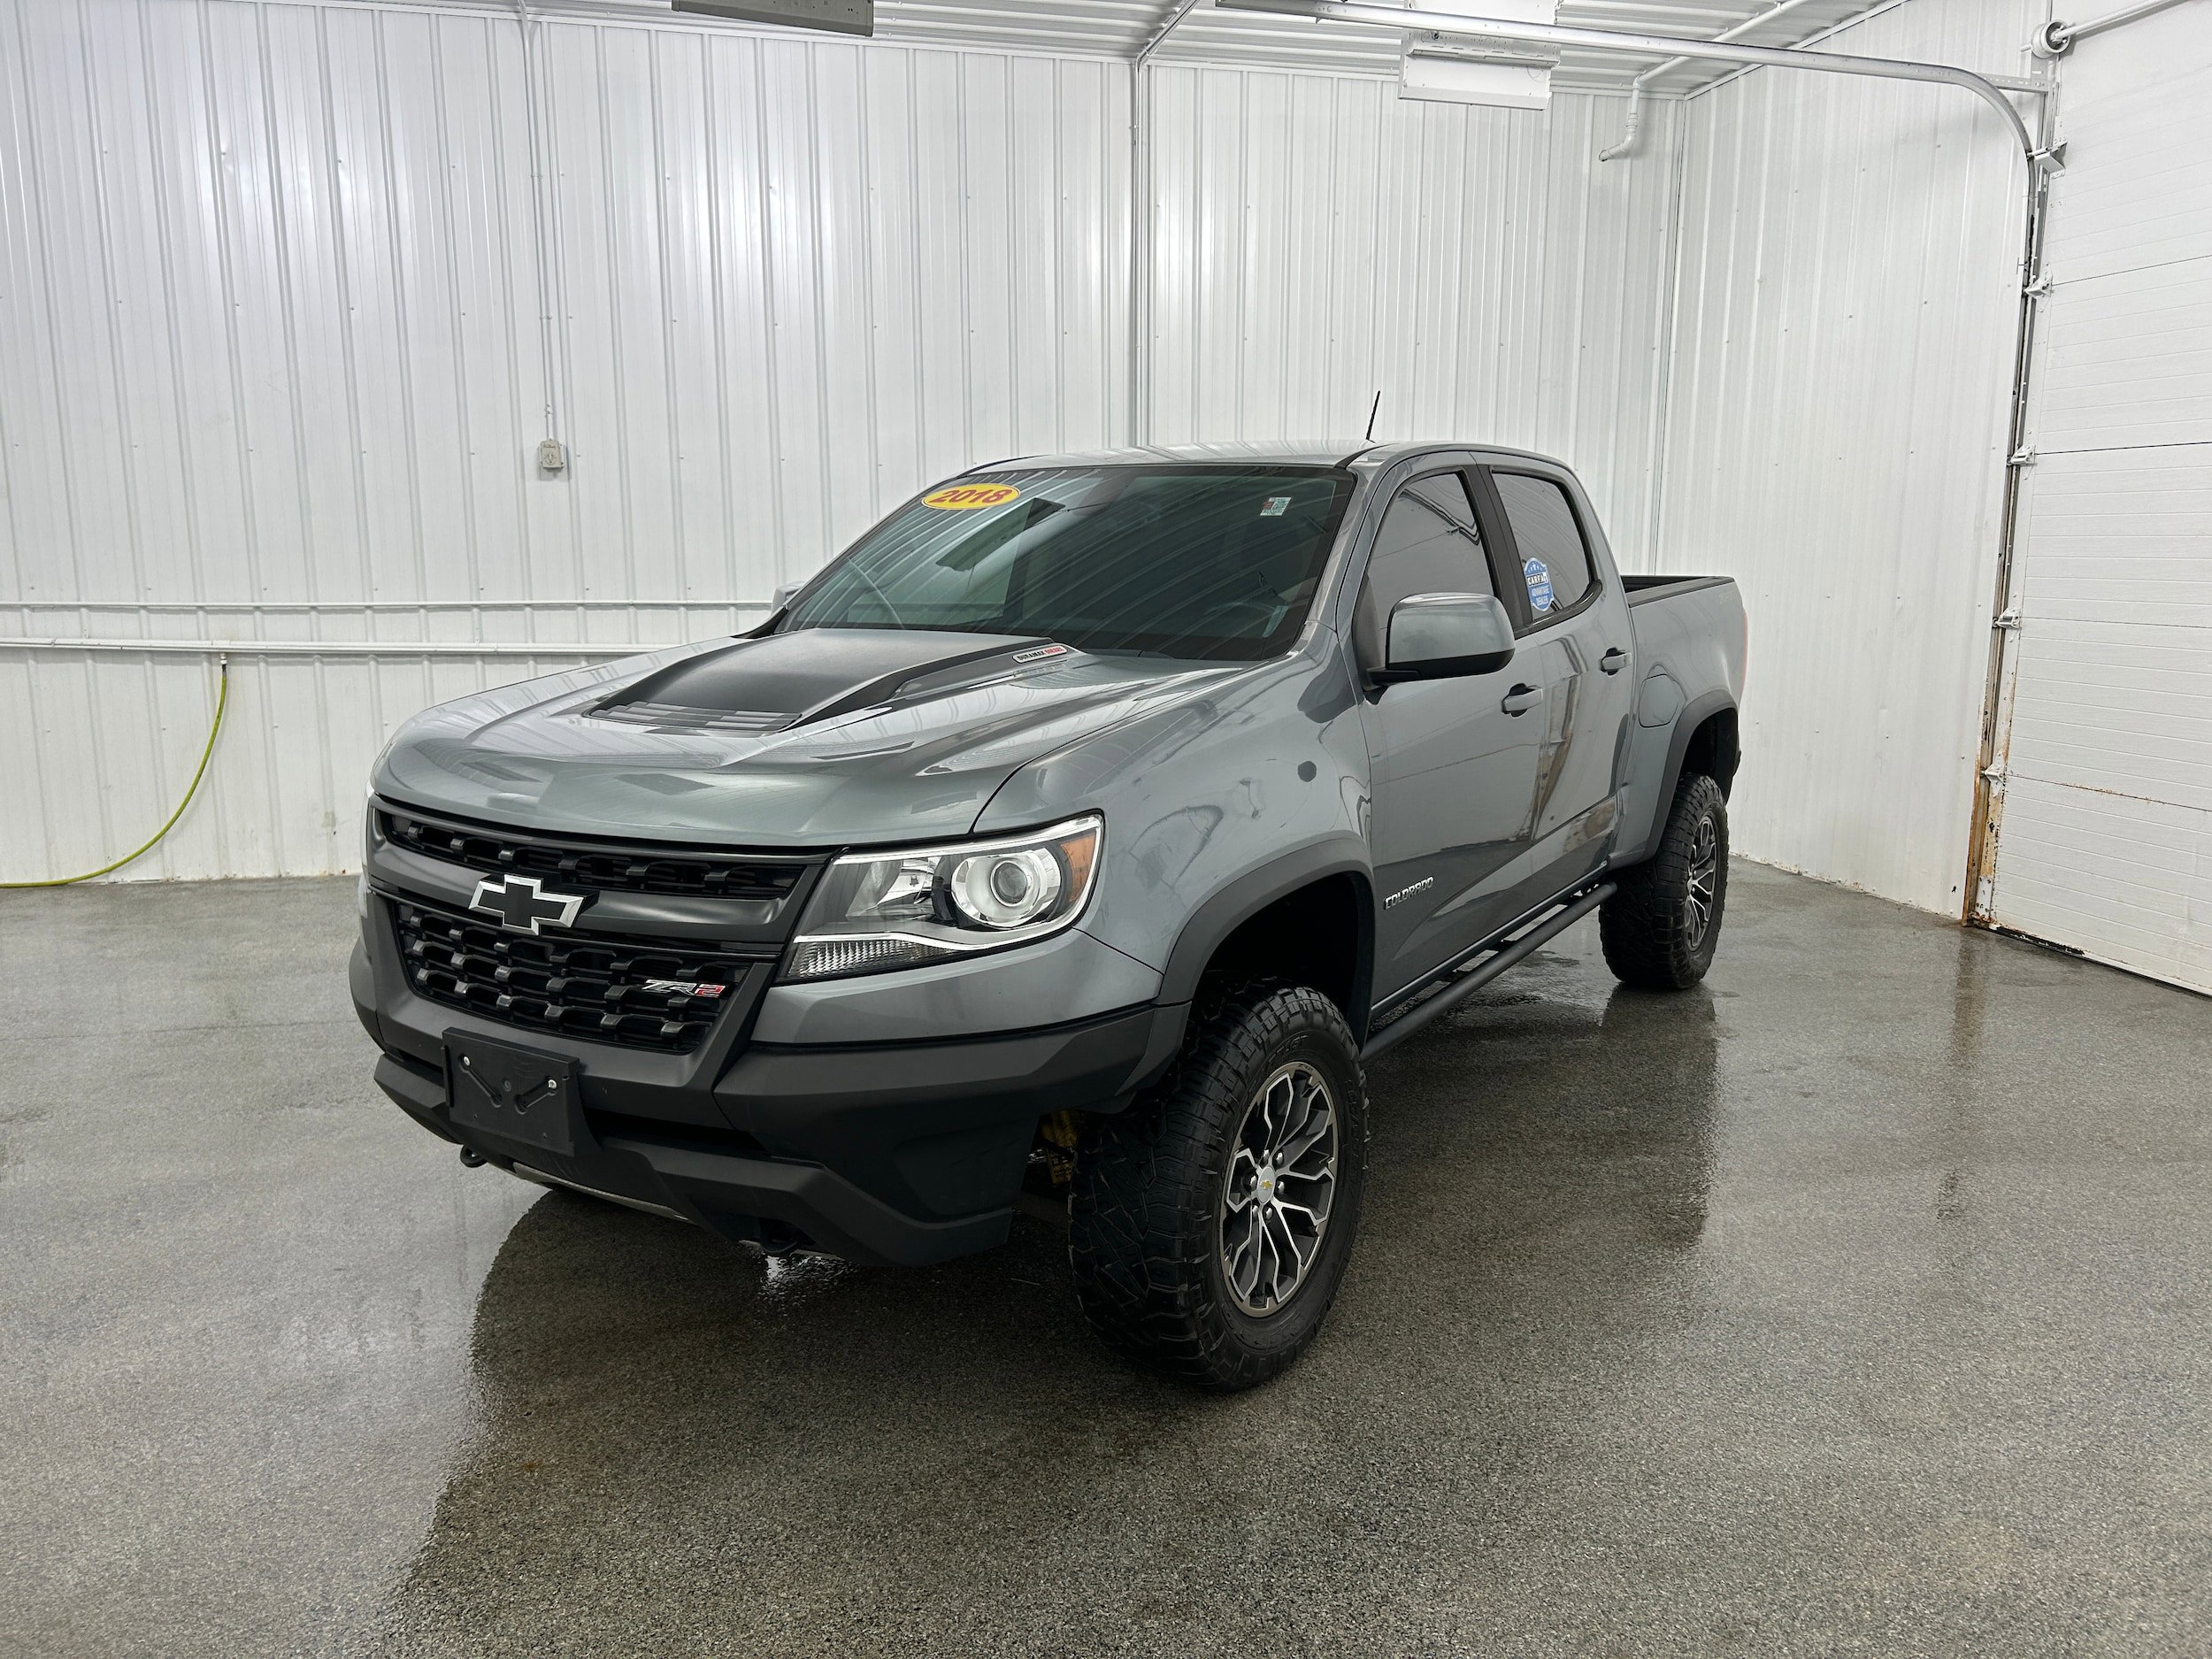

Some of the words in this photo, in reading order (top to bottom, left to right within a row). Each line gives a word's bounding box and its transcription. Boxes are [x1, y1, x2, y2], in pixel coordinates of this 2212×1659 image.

[928, 489, 1013, 503] 2018
[1385, 876, 1433, 909] COLORADO
[641, 979, 726, 998] ZR2
